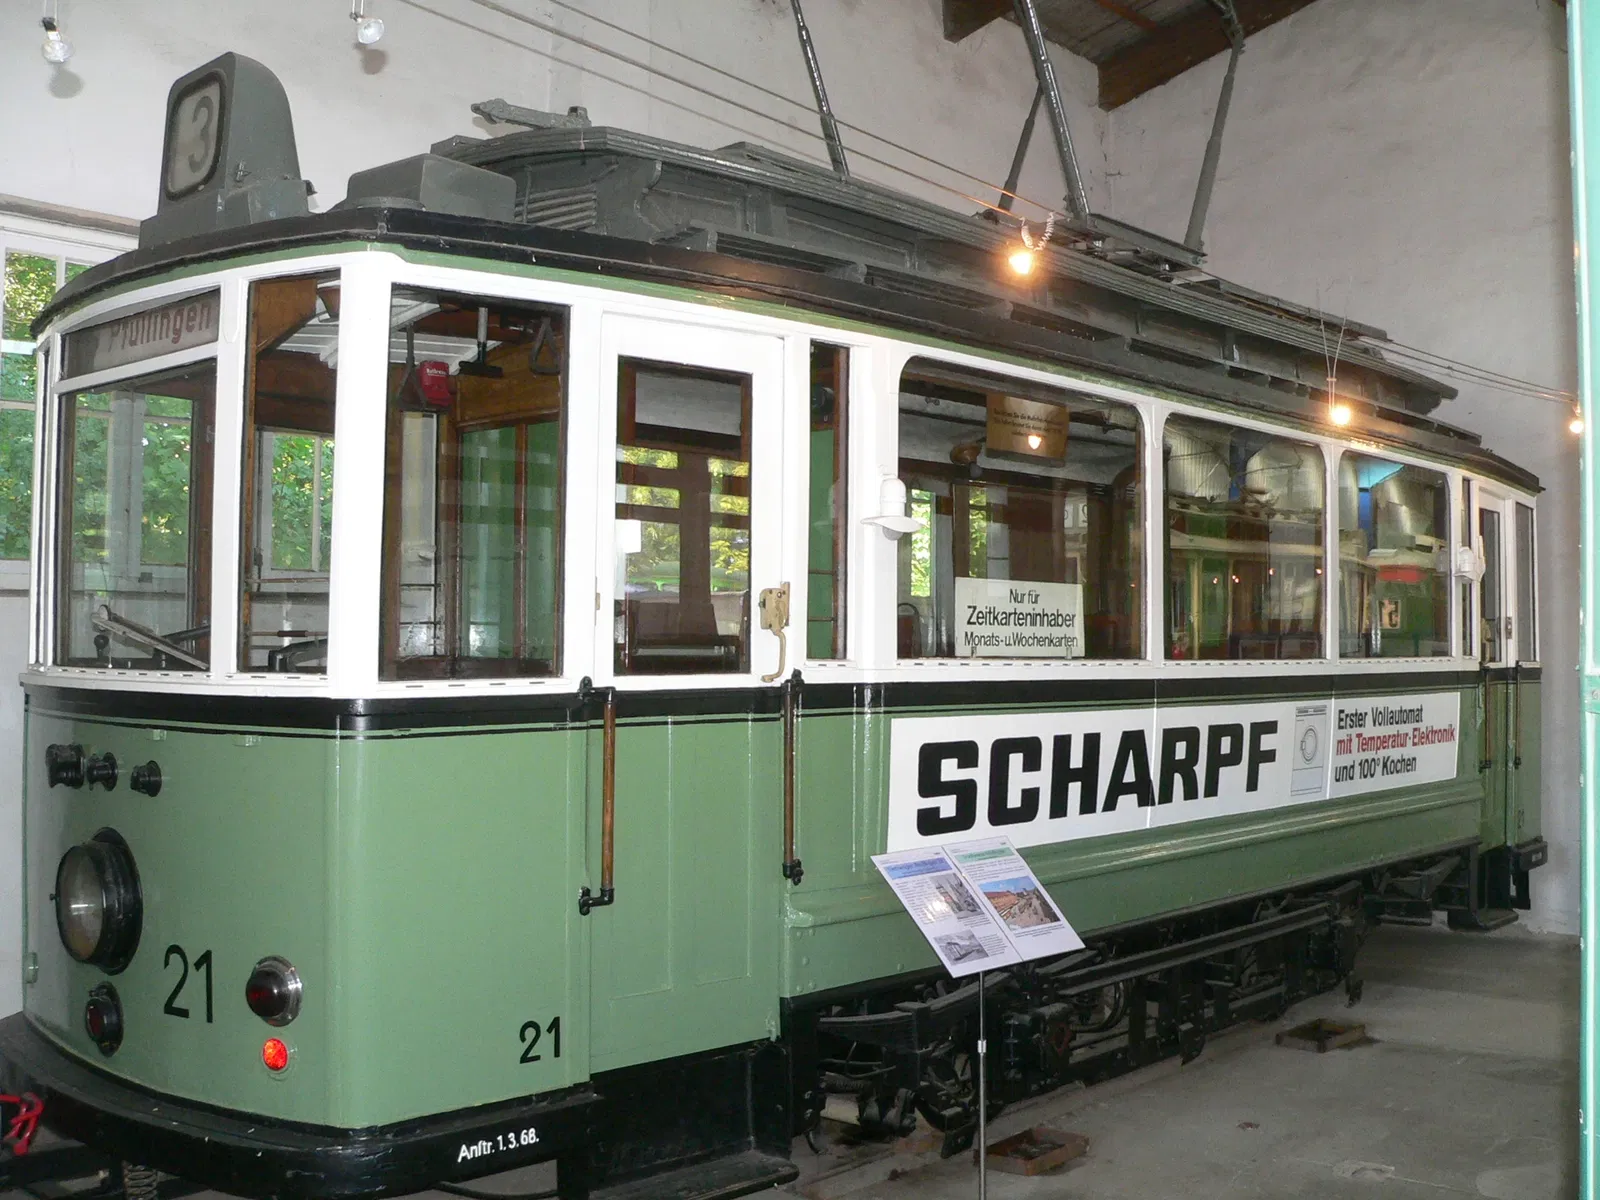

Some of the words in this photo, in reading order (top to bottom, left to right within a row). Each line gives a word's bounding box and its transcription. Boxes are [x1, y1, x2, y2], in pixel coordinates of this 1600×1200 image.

[187, 96, 214, 174] 3
[1009, 588, 1026, 604] Nur
[1027, 589, 1041, 605] für
[966, 605, 1077, 628] Zeitkarteninhaber
[1337, 709, 1368, 730] Erster
[1371, 704, 1424, 728] Vollautomat
[1336, 734, 1353, 756] mit
[916, 720, 1279, 837] SCHARPF
[1334, 760, 1356, 783] und
[1381, 754, 1417, 777] Kochen
[163, 944, 214, 1024] 21
[519, 1016, 561, 1065] 21
